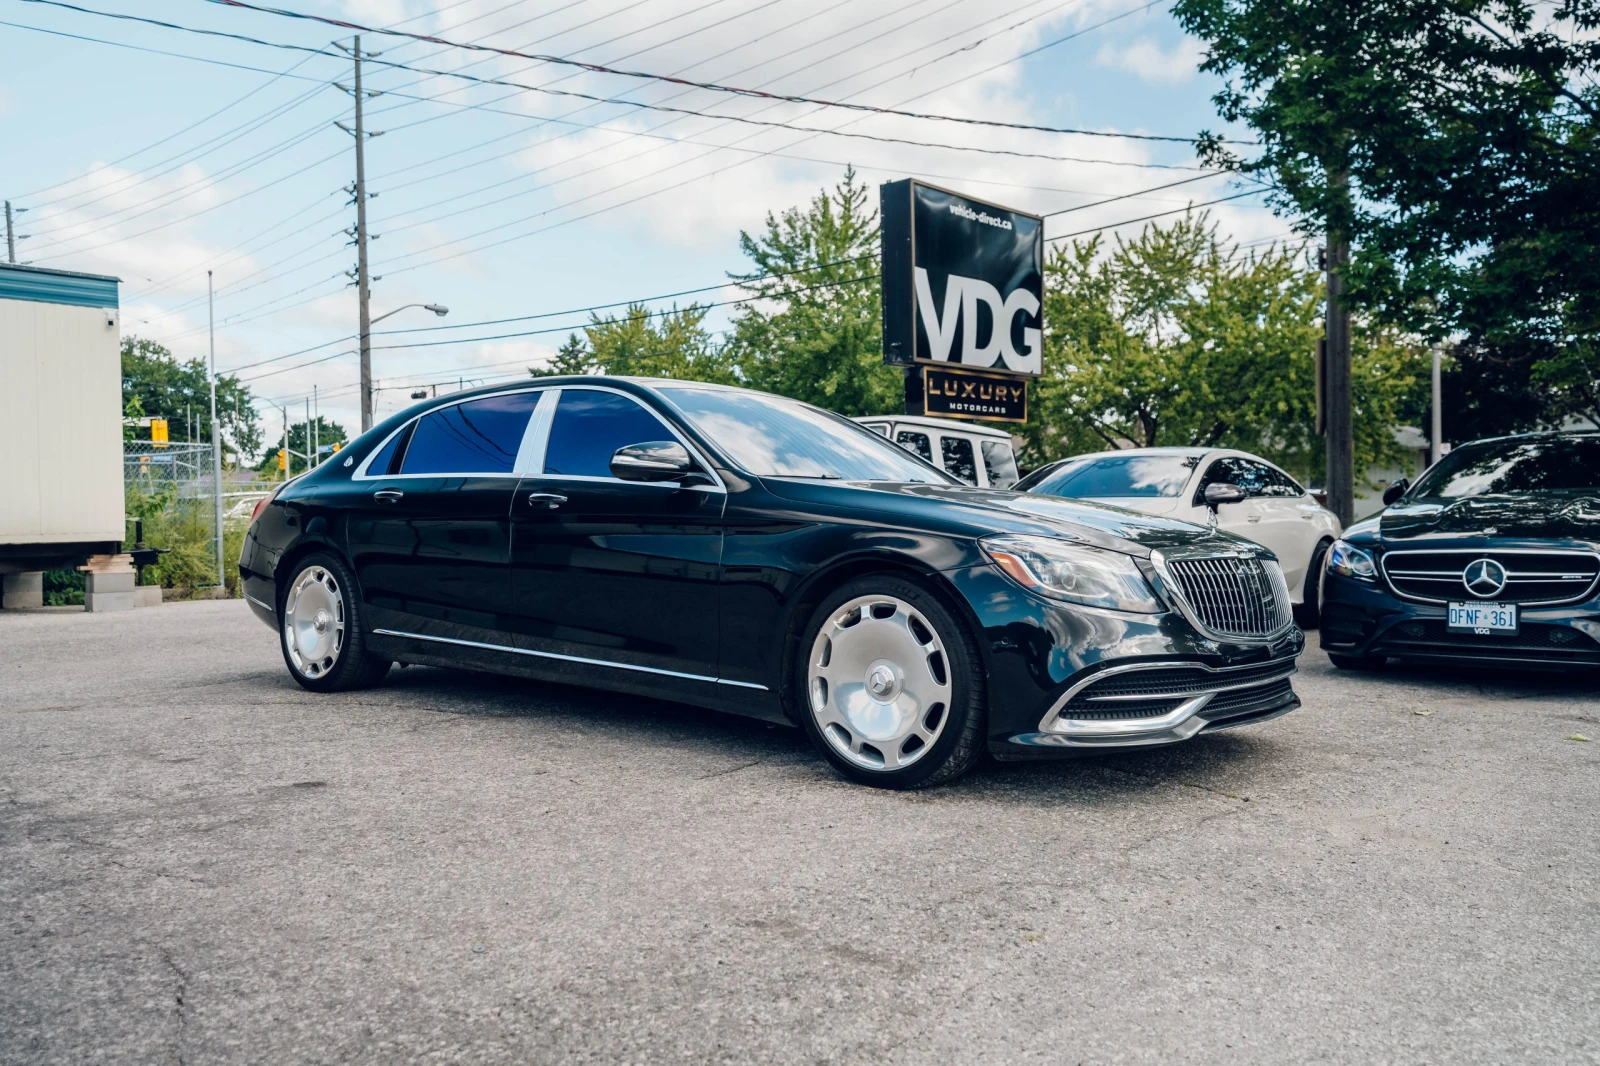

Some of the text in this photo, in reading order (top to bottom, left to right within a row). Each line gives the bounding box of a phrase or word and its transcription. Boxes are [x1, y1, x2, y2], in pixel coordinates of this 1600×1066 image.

[949, 204, 1012, 230] vehicle-direct.ca
[914, 266, 1042, 375] VDG
[929, 378, 1022, 403] LUXURY
[949, 402, 1006, 414] MOTORCARS
[1450, 609, 1514, 627] DFNF 361
